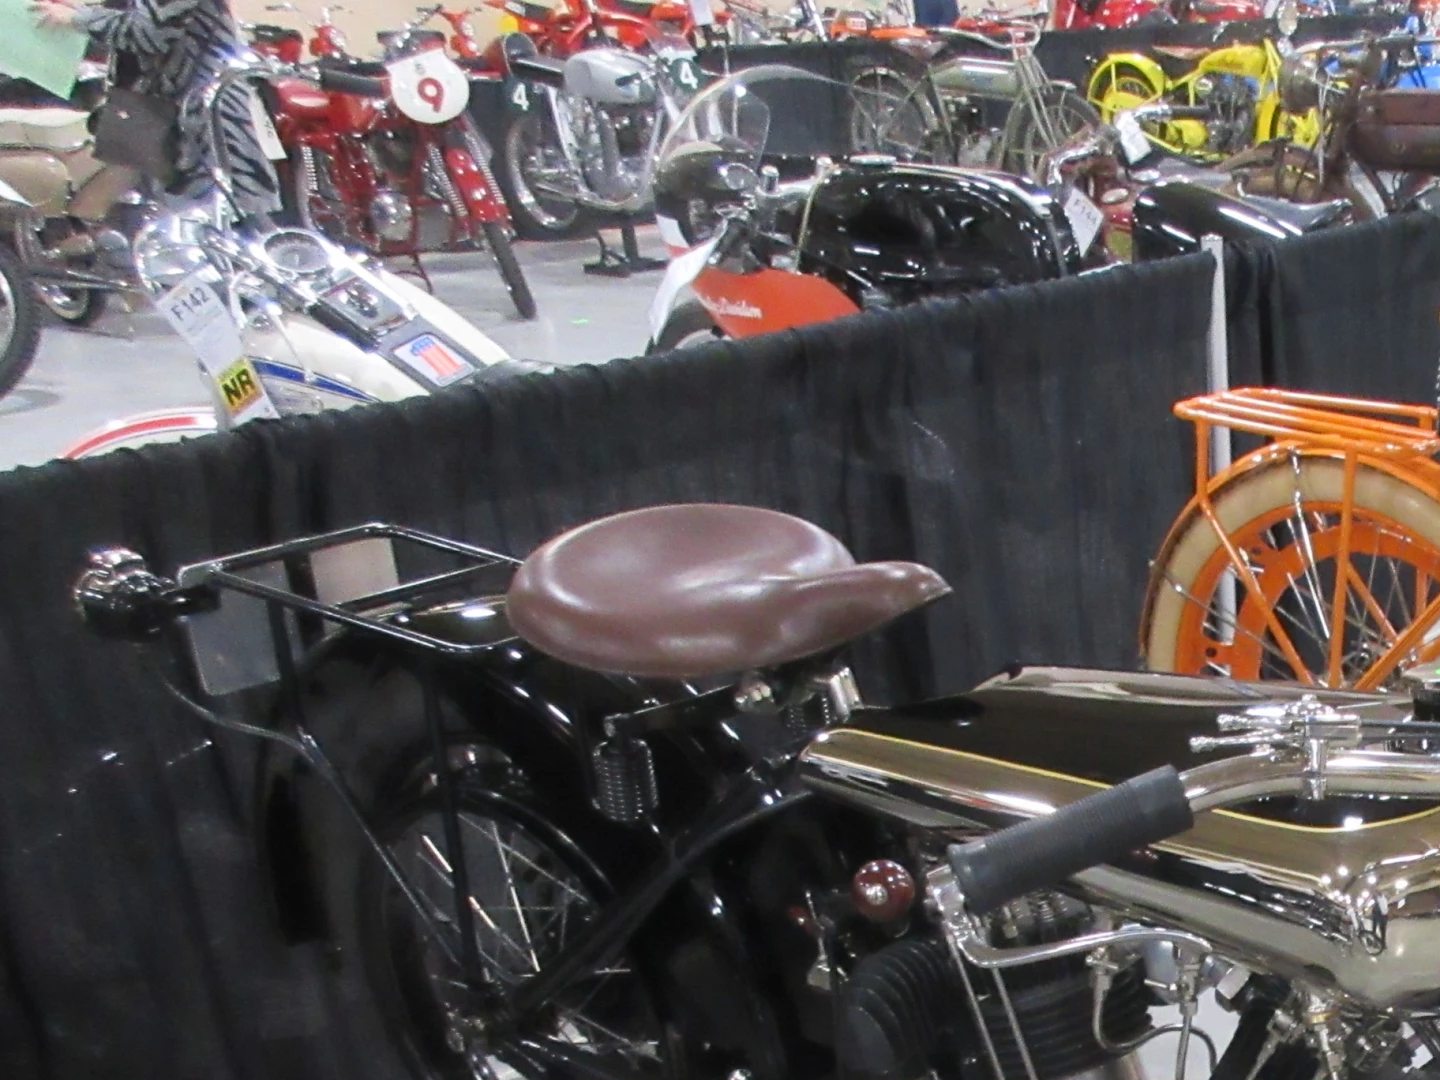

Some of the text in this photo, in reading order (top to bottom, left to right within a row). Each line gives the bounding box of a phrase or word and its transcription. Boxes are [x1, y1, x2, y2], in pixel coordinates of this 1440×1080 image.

[679, 61, 699, 89] 4
[417, 77, 444, 113] 9
[513, 82, 531, 111] 4
[170, 287, 210, 321] F142
[221, 368, 256, 406] NR
